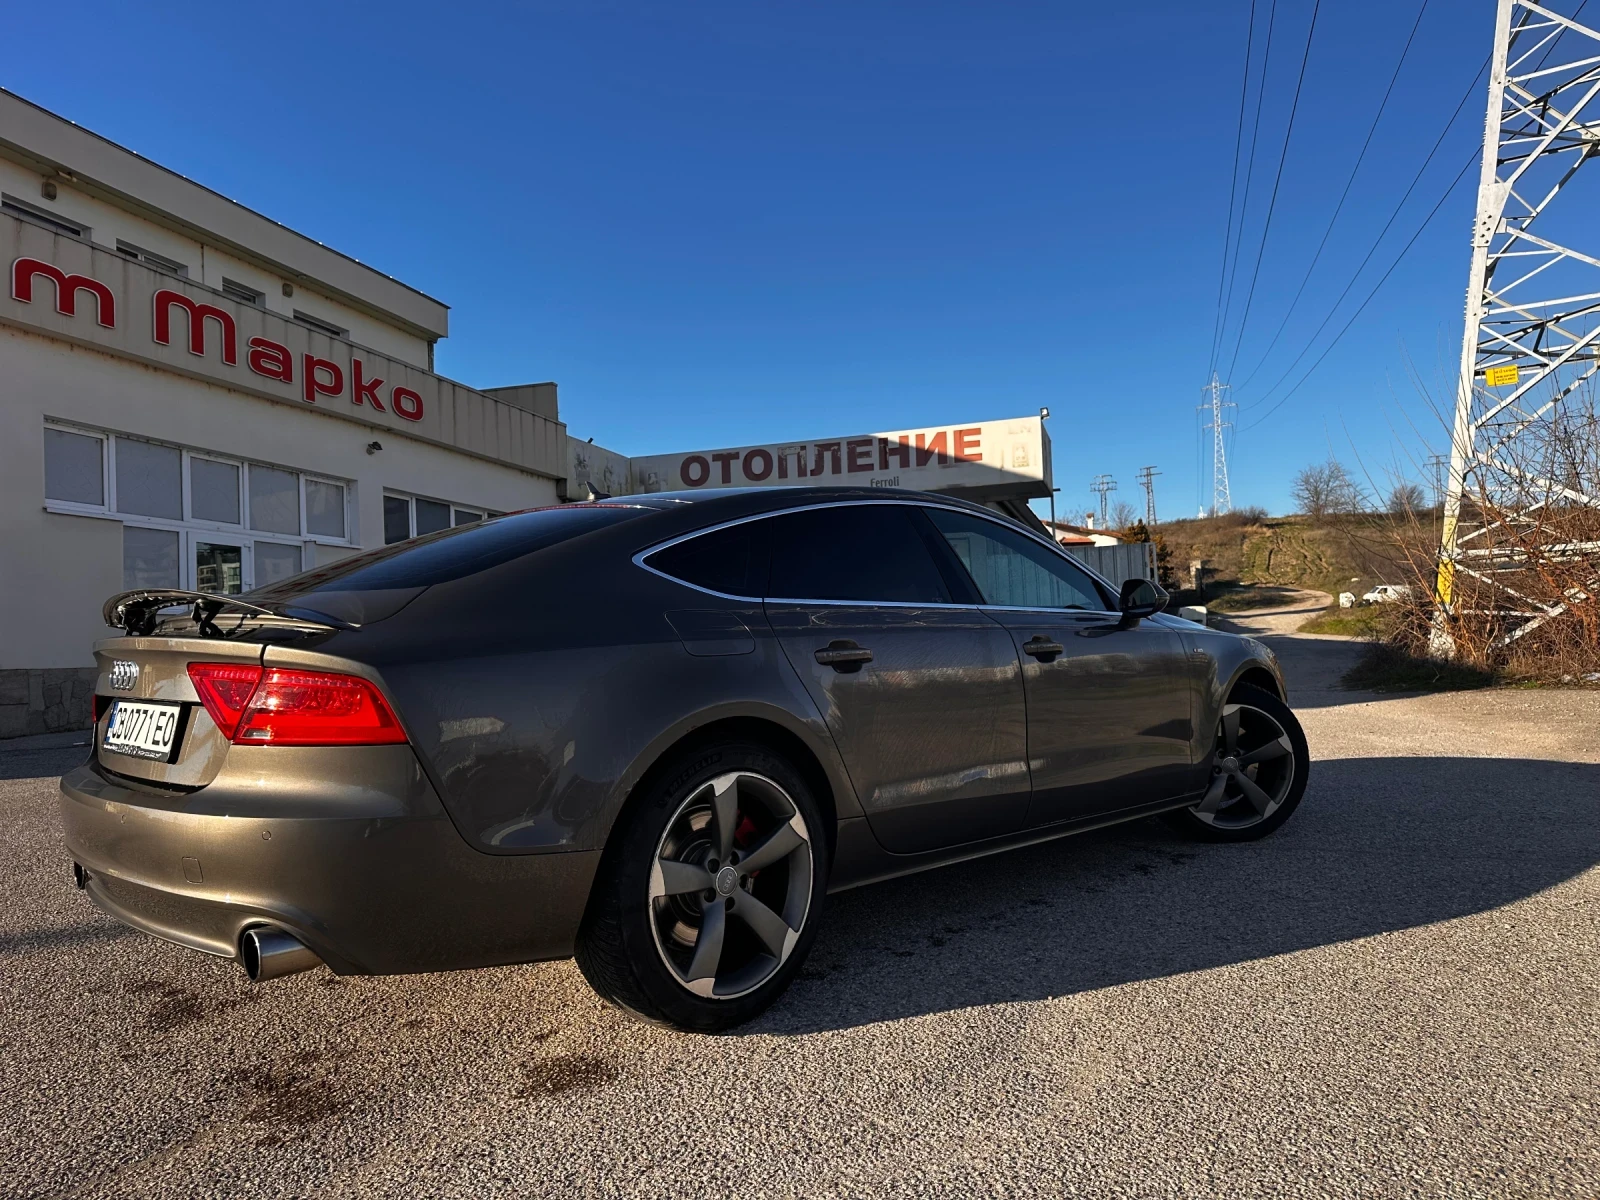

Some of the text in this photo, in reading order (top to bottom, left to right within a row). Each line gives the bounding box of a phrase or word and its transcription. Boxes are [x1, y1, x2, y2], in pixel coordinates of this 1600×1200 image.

[680, 427, 983, 487] ОТОПЛЕНИЕ
[870, 476, 900, 488] Ferroli
[669, 752, 723, 794] MICHELIN
